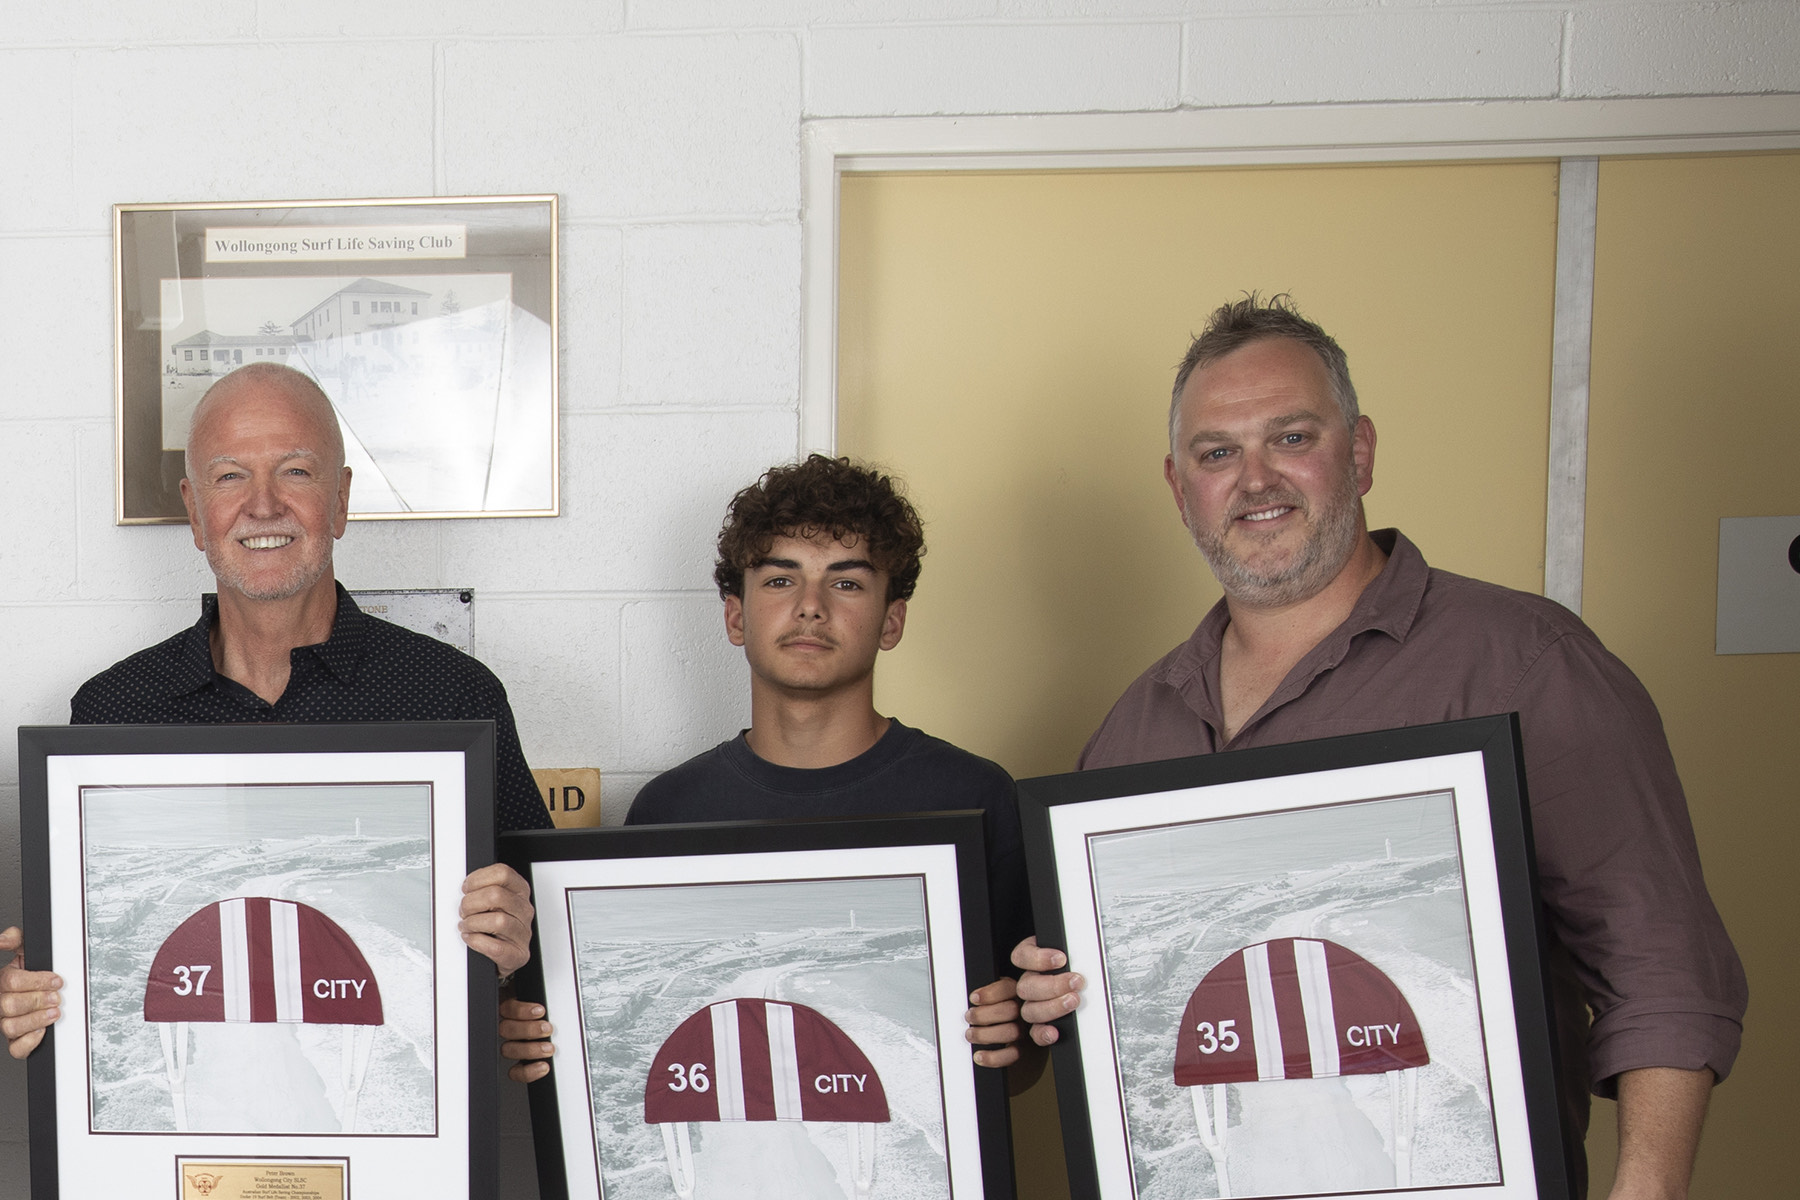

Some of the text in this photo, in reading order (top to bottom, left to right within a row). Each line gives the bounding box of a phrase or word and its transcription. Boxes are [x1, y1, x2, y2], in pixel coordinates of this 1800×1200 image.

[214, 235, 453, 254] Wollongong Surf Life Saving Club
[360, 604, 388, 614] TONE
[172, 964, 212, 996] 37
[312, 979, 367, 999] CITY
[1196, 1018, 1240, 1055] 35
[1345, 1022, 1401, 1047] CITY
[667, 1062, 710, 1093] 36
[813, 1073, 868, 1094] CITY
